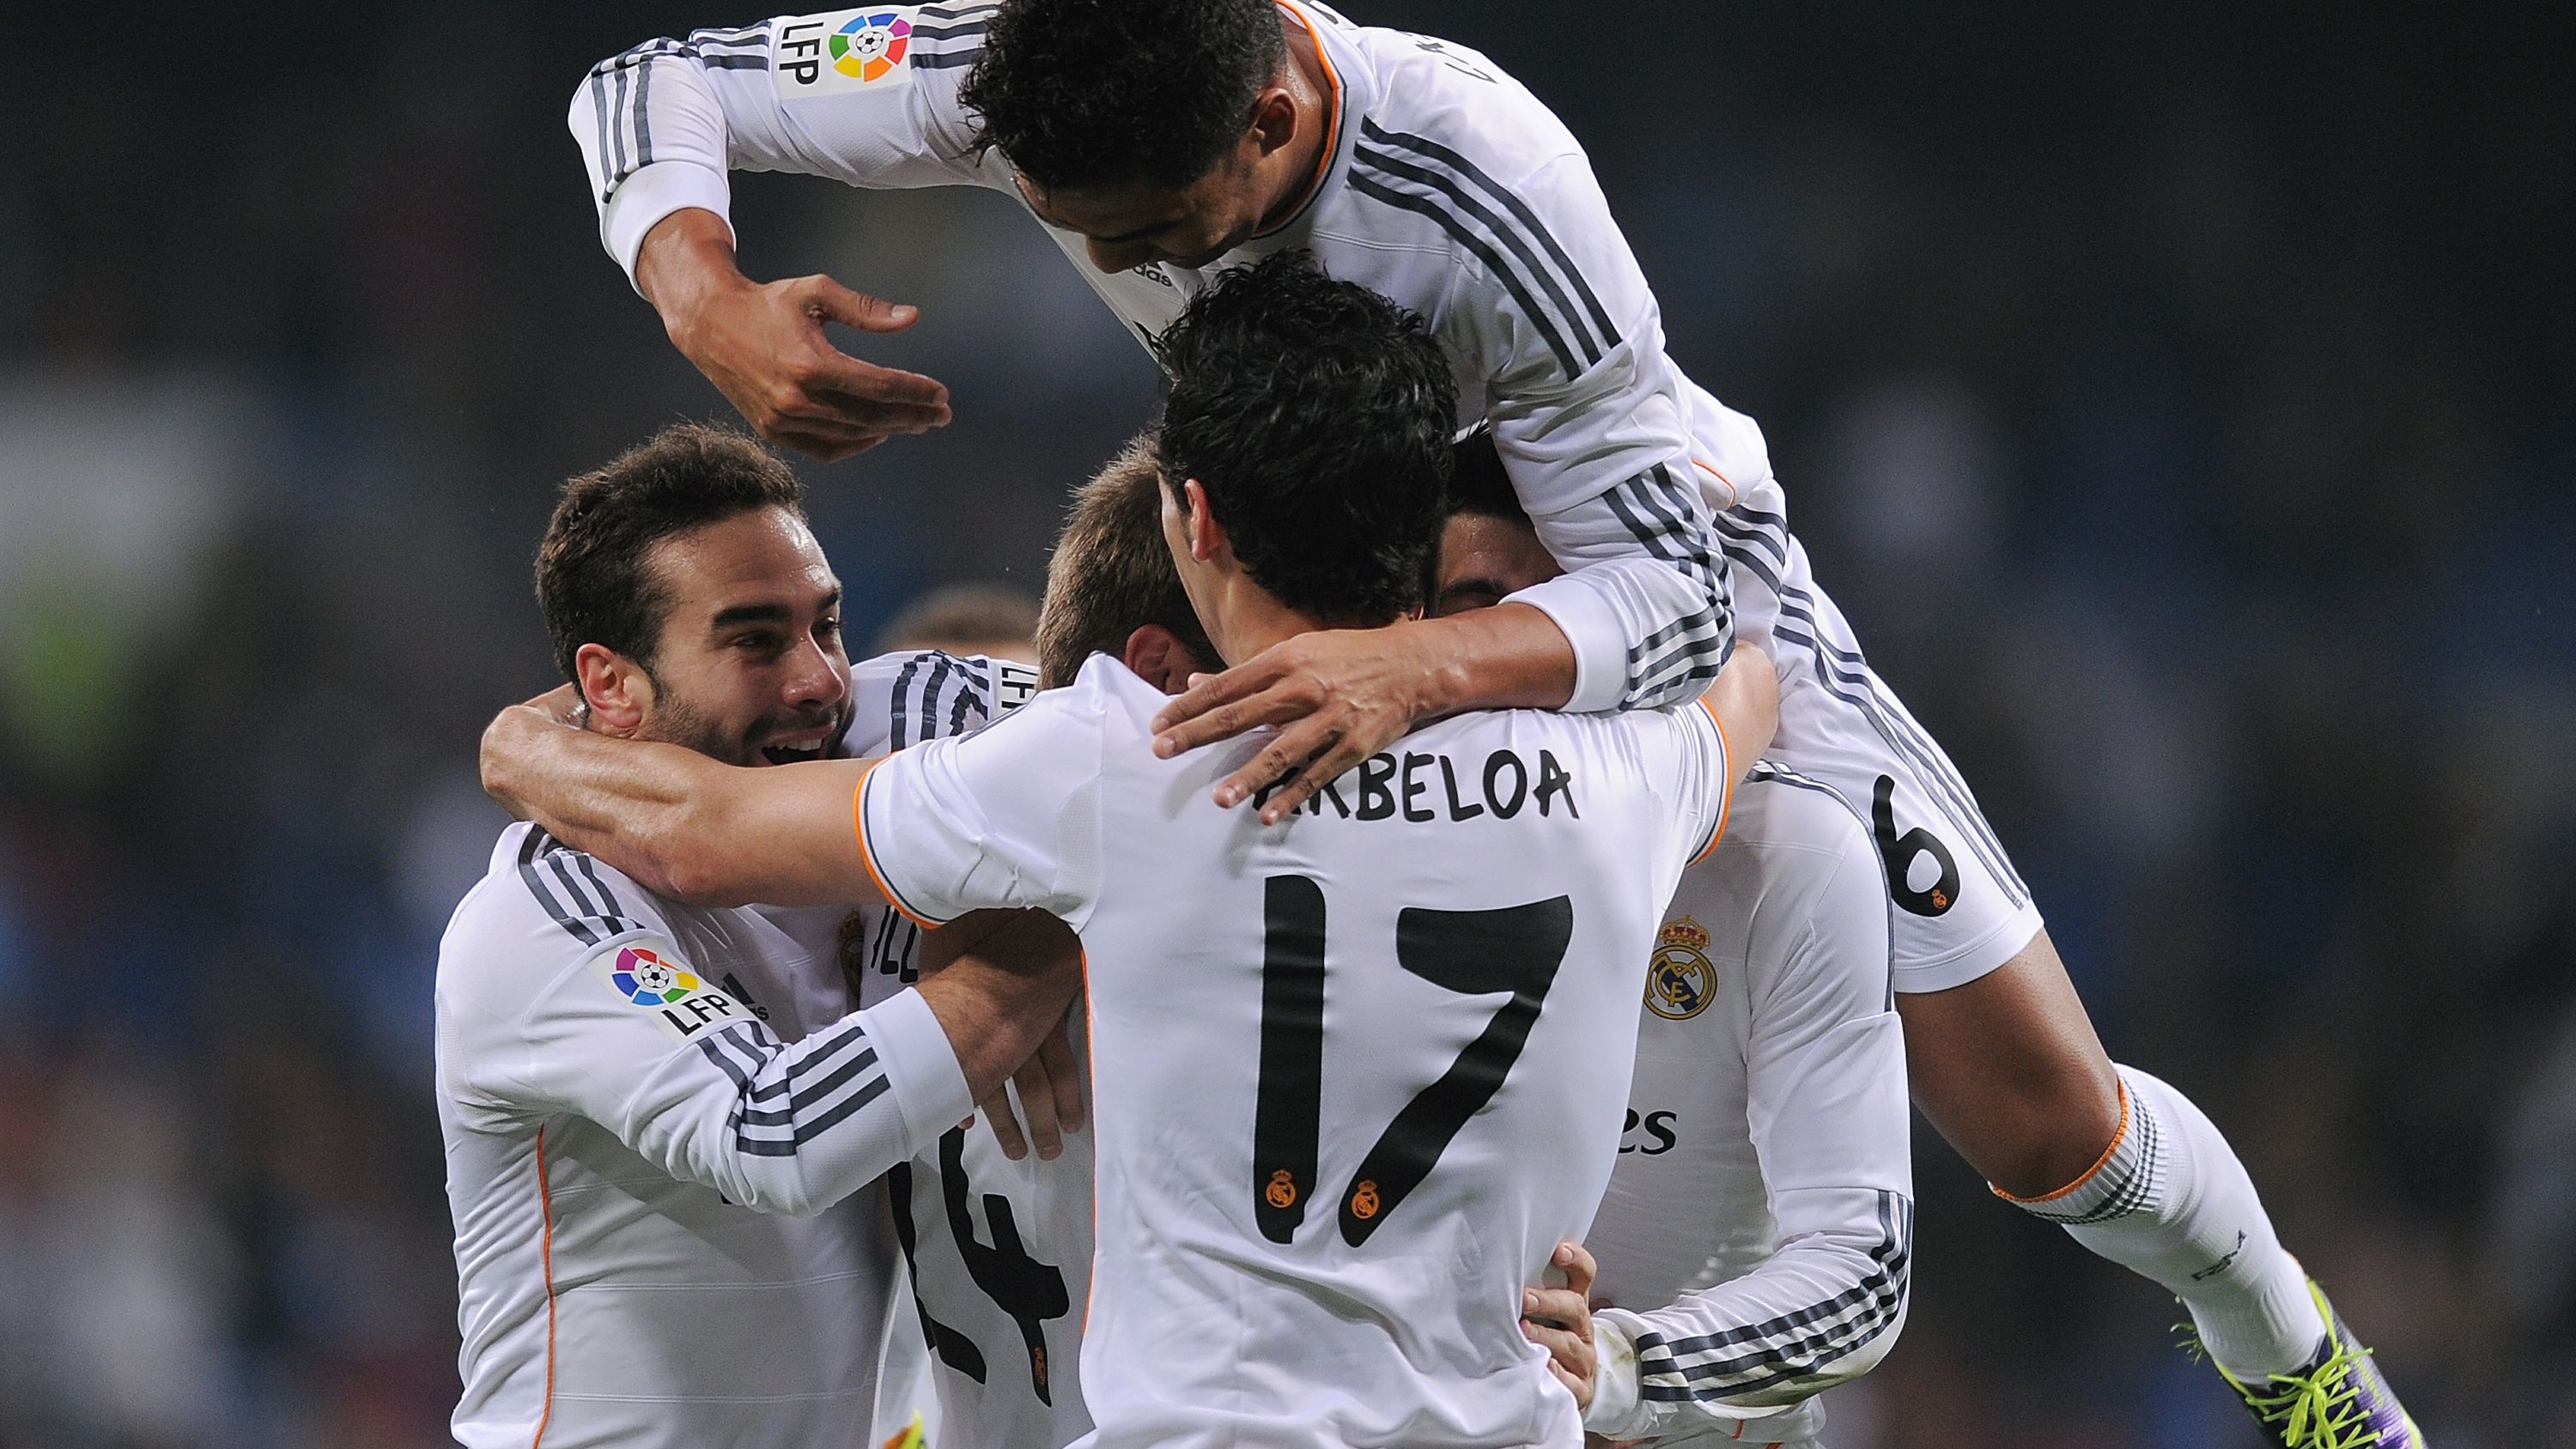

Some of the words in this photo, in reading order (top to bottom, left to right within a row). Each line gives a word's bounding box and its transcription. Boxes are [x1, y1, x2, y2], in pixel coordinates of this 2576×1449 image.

[779, 21, 824, 85] LFP
[1872, 774, 1960, 917] 6
[662, 993, 730, 1036] LFP
[1254, 874, 1573, 1248] 17
